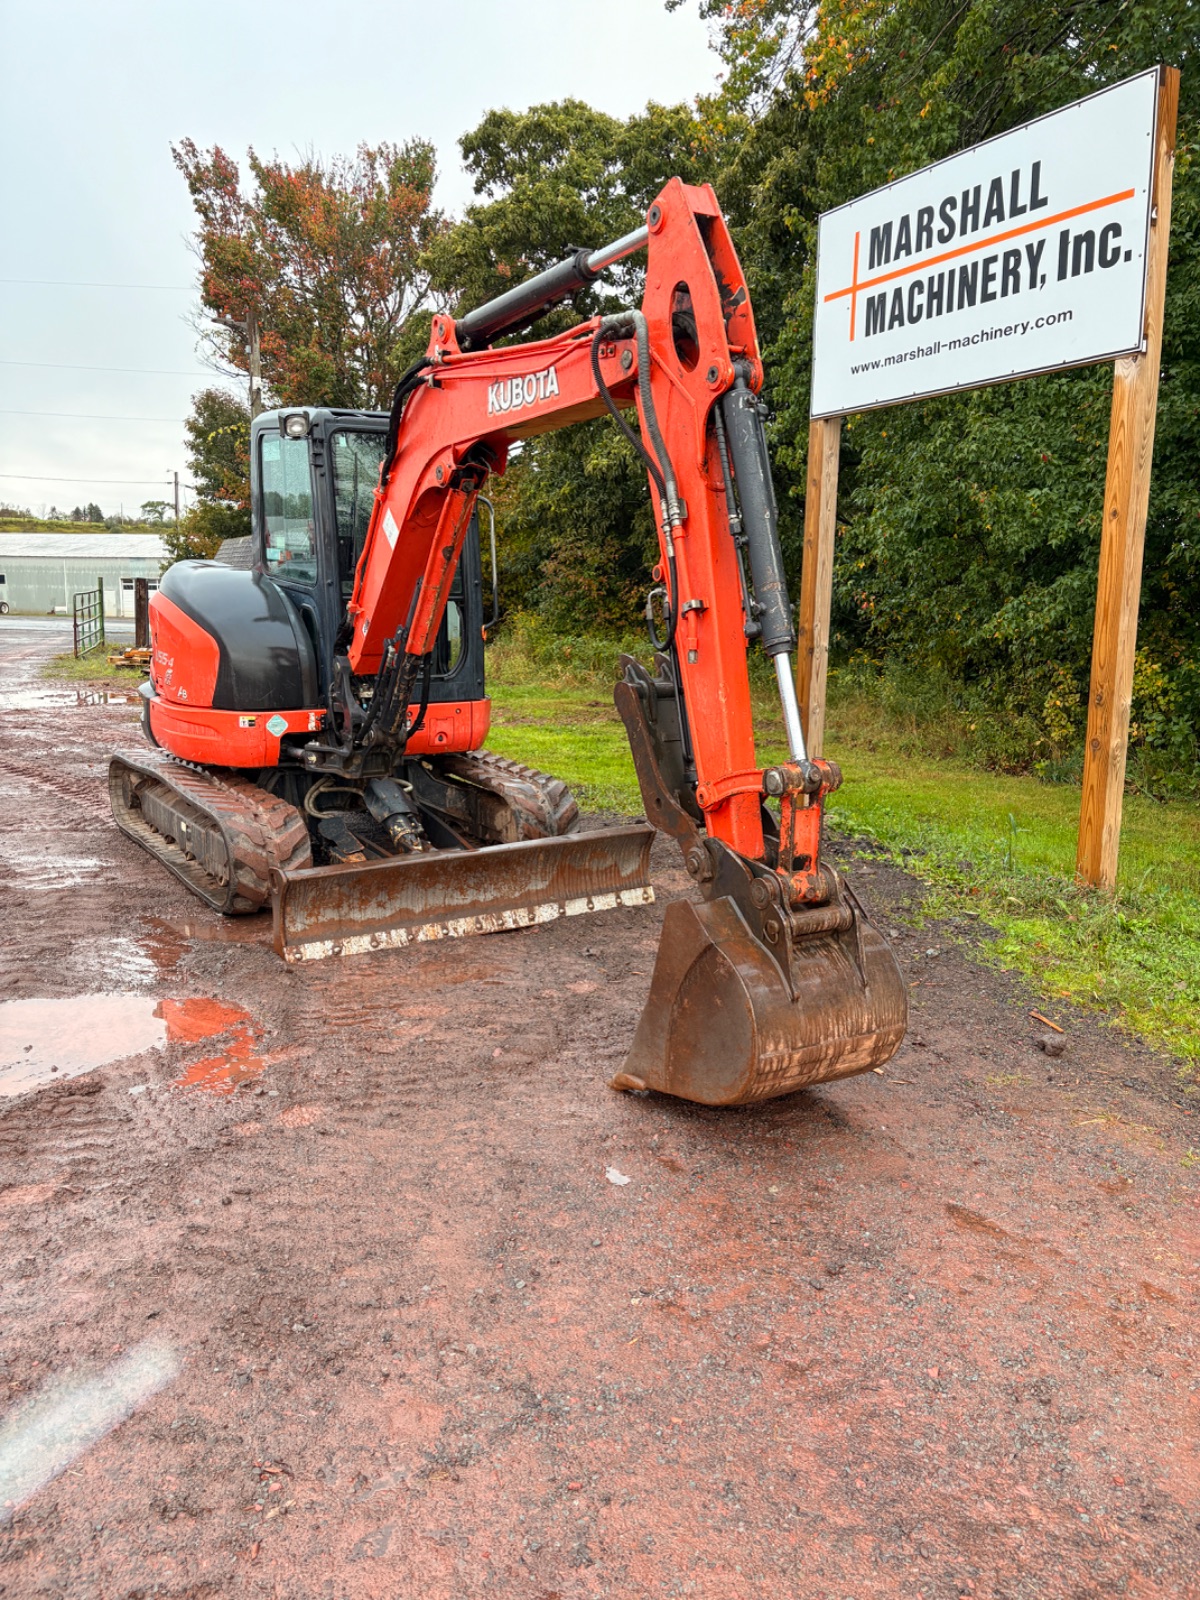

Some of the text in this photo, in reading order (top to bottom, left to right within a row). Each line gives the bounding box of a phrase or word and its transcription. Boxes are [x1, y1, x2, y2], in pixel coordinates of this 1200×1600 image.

[868, 161, 1048, 270] MARSHALL
[865, 222, 1132, 337] MACHINERY, Inc.
[851, 310, 1073, 374] www.marshall-machinery.com
[488, 366, 559, 413] KUBOTA
